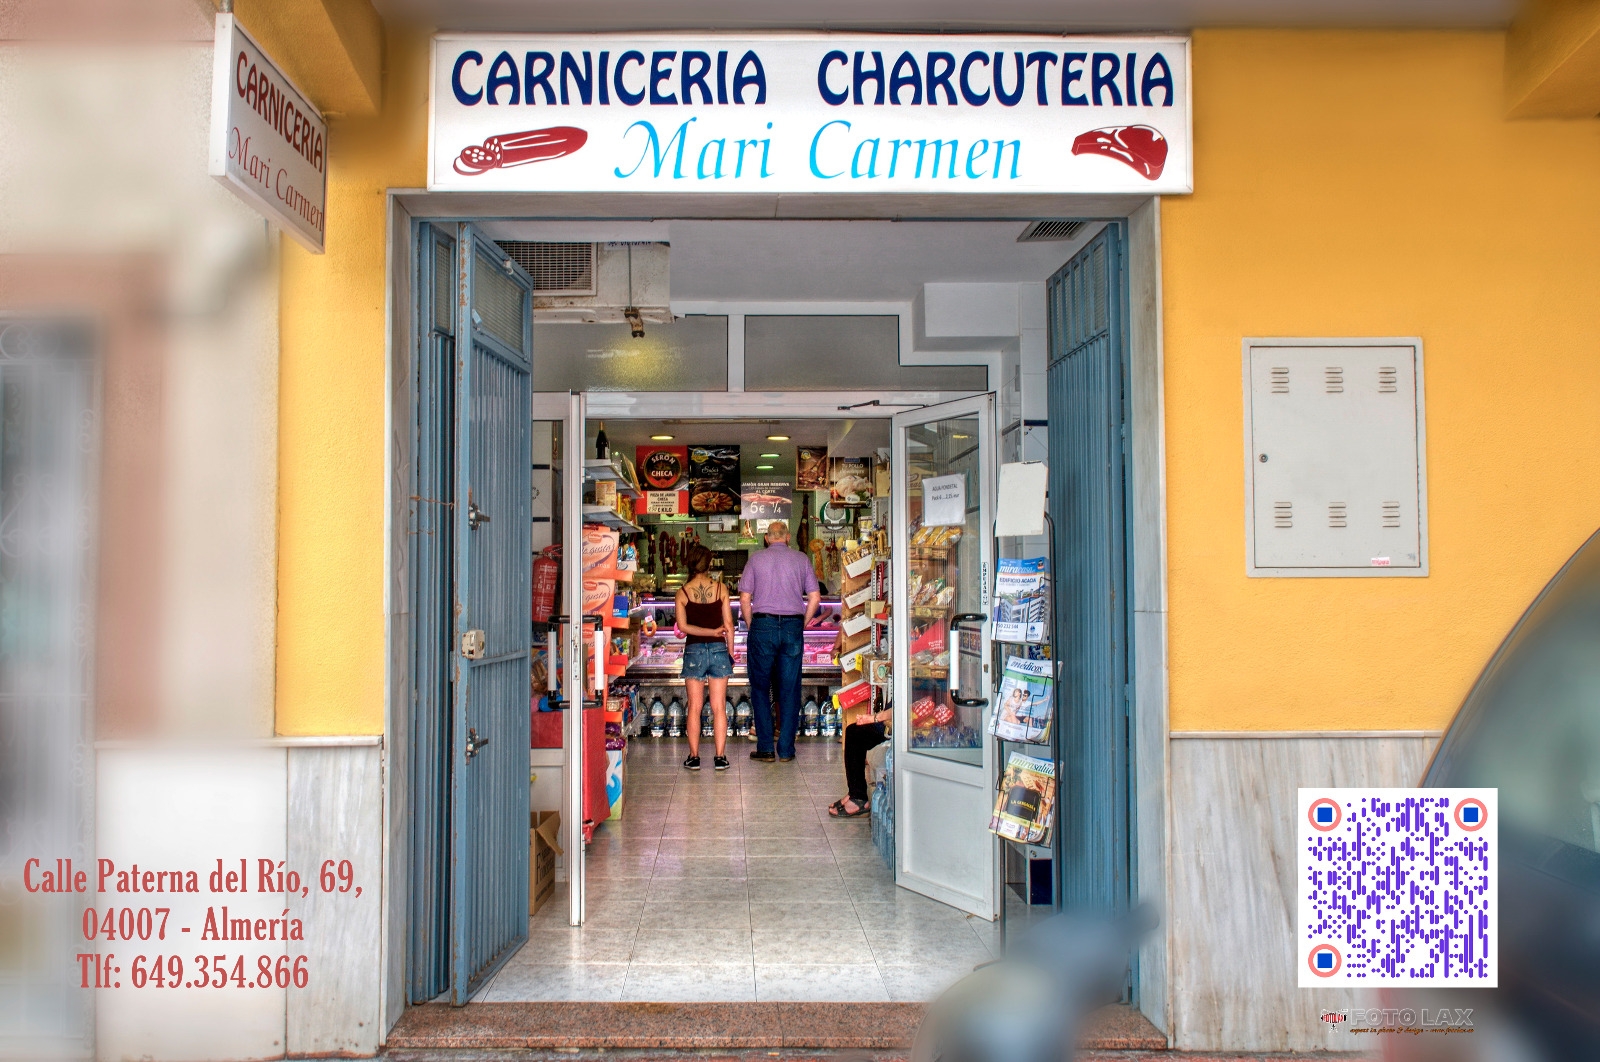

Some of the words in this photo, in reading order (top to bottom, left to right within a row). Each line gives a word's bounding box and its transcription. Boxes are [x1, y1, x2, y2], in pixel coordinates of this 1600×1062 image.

[237, 51, 323, 173] CARNICERIA
[451, 50, 767, 106] CARNICERIA
[817, 50, 1174, 107] CHARCUTERIA
[228, 127, 271, 189] Mari
[276, 168, 324, 231] Carmen
[614, 116, 775, 180] Mari
[809, 120, 1022, 180] Carmen
